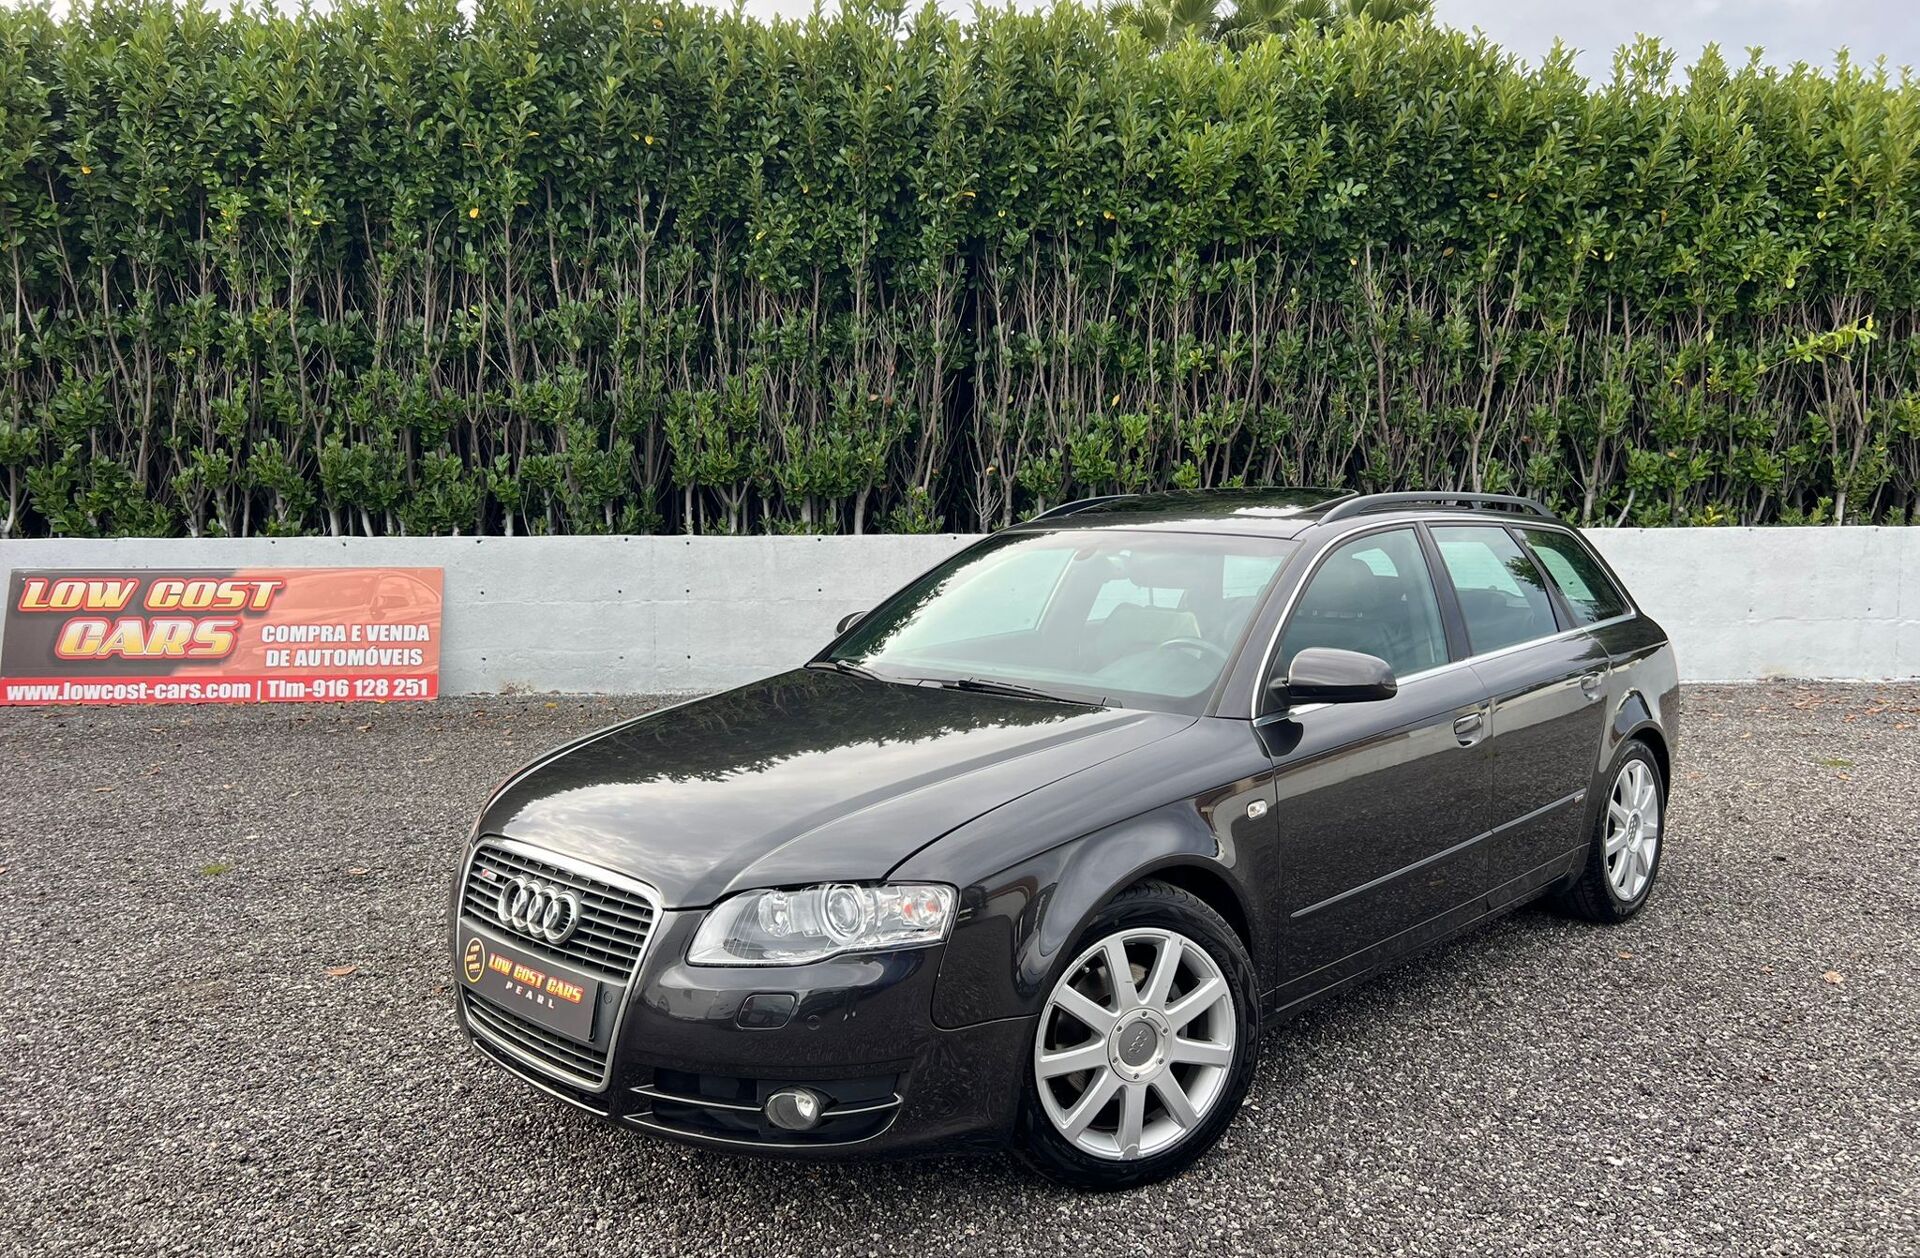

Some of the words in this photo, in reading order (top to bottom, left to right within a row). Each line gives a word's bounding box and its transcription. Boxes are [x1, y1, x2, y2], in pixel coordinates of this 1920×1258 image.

[19, 577, 139, 611] LOW
[147, 577, 285, 611] COST
[56, 617, 242, 659] CARS
[261, 625, 347, 643] COMPRA
[351, 625, 361, 642] E
[365, 624, 430, 642] VENDA
[265, 650, 290, 667] DE
[294, 645, 423, 667] AUTOMÓVEIS
[6, 681, 251, 701] www.lowcost-cars.com
[353, 678, 389, 697] 128
[392, 678, 428, 697] 251
[488, 953, 513, 976] LOW
[513, 964, 546, 988] COST
[545, 976, 584, 1004] CARS
[505, 980, 555, 1009] PEARL
